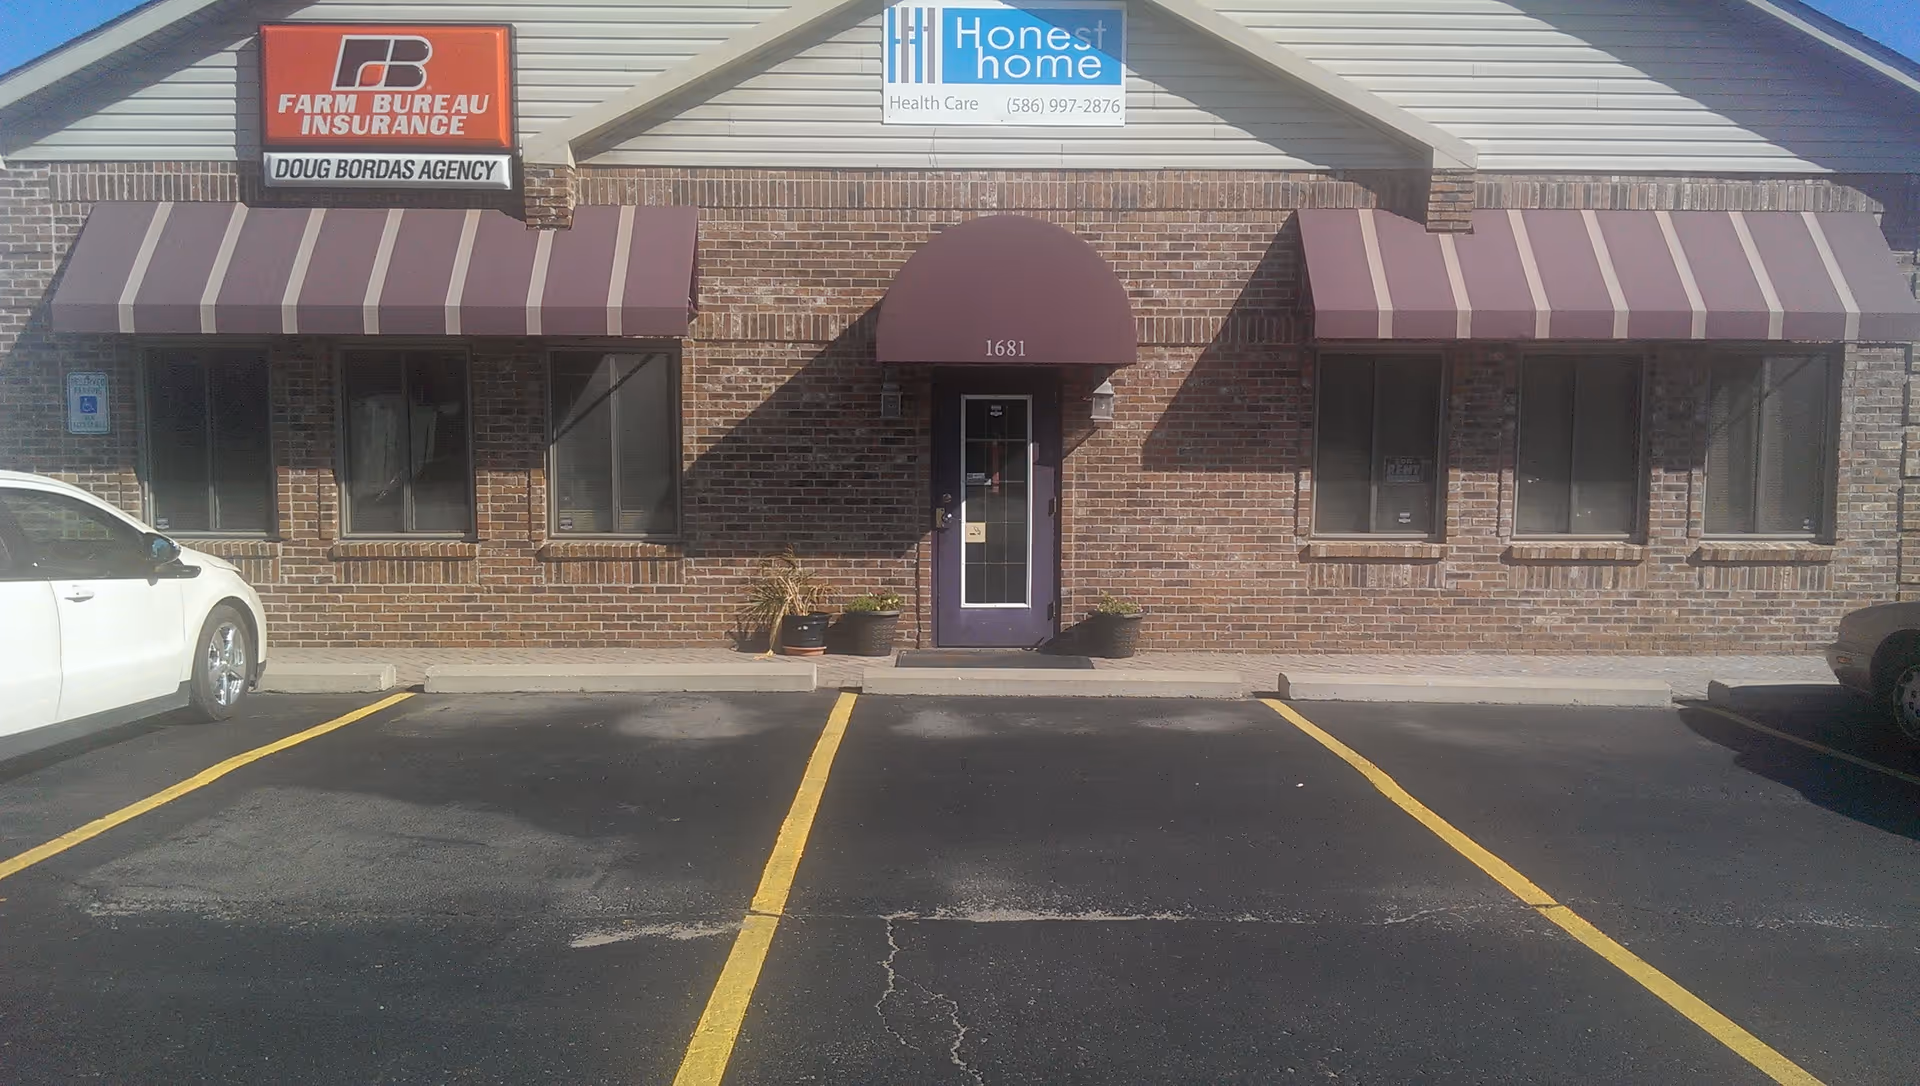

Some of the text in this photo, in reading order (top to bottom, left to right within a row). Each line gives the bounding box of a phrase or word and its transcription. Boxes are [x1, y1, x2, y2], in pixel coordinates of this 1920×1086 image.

[956, 17, 1107, 50] Honest
[977, 46, 1102, 80] home
[277, 94, 490, 114] FARM BUREAU
[889, 95, 979, 111] Health Care
[1006, 98, 1121, 115] (586) 997-2876
[301, 115, 469, 135] INSURANCE
[275, 159, 498, 181] DOUG BORDAS AGENCY
[986, 339, 1026, 357] 1681
